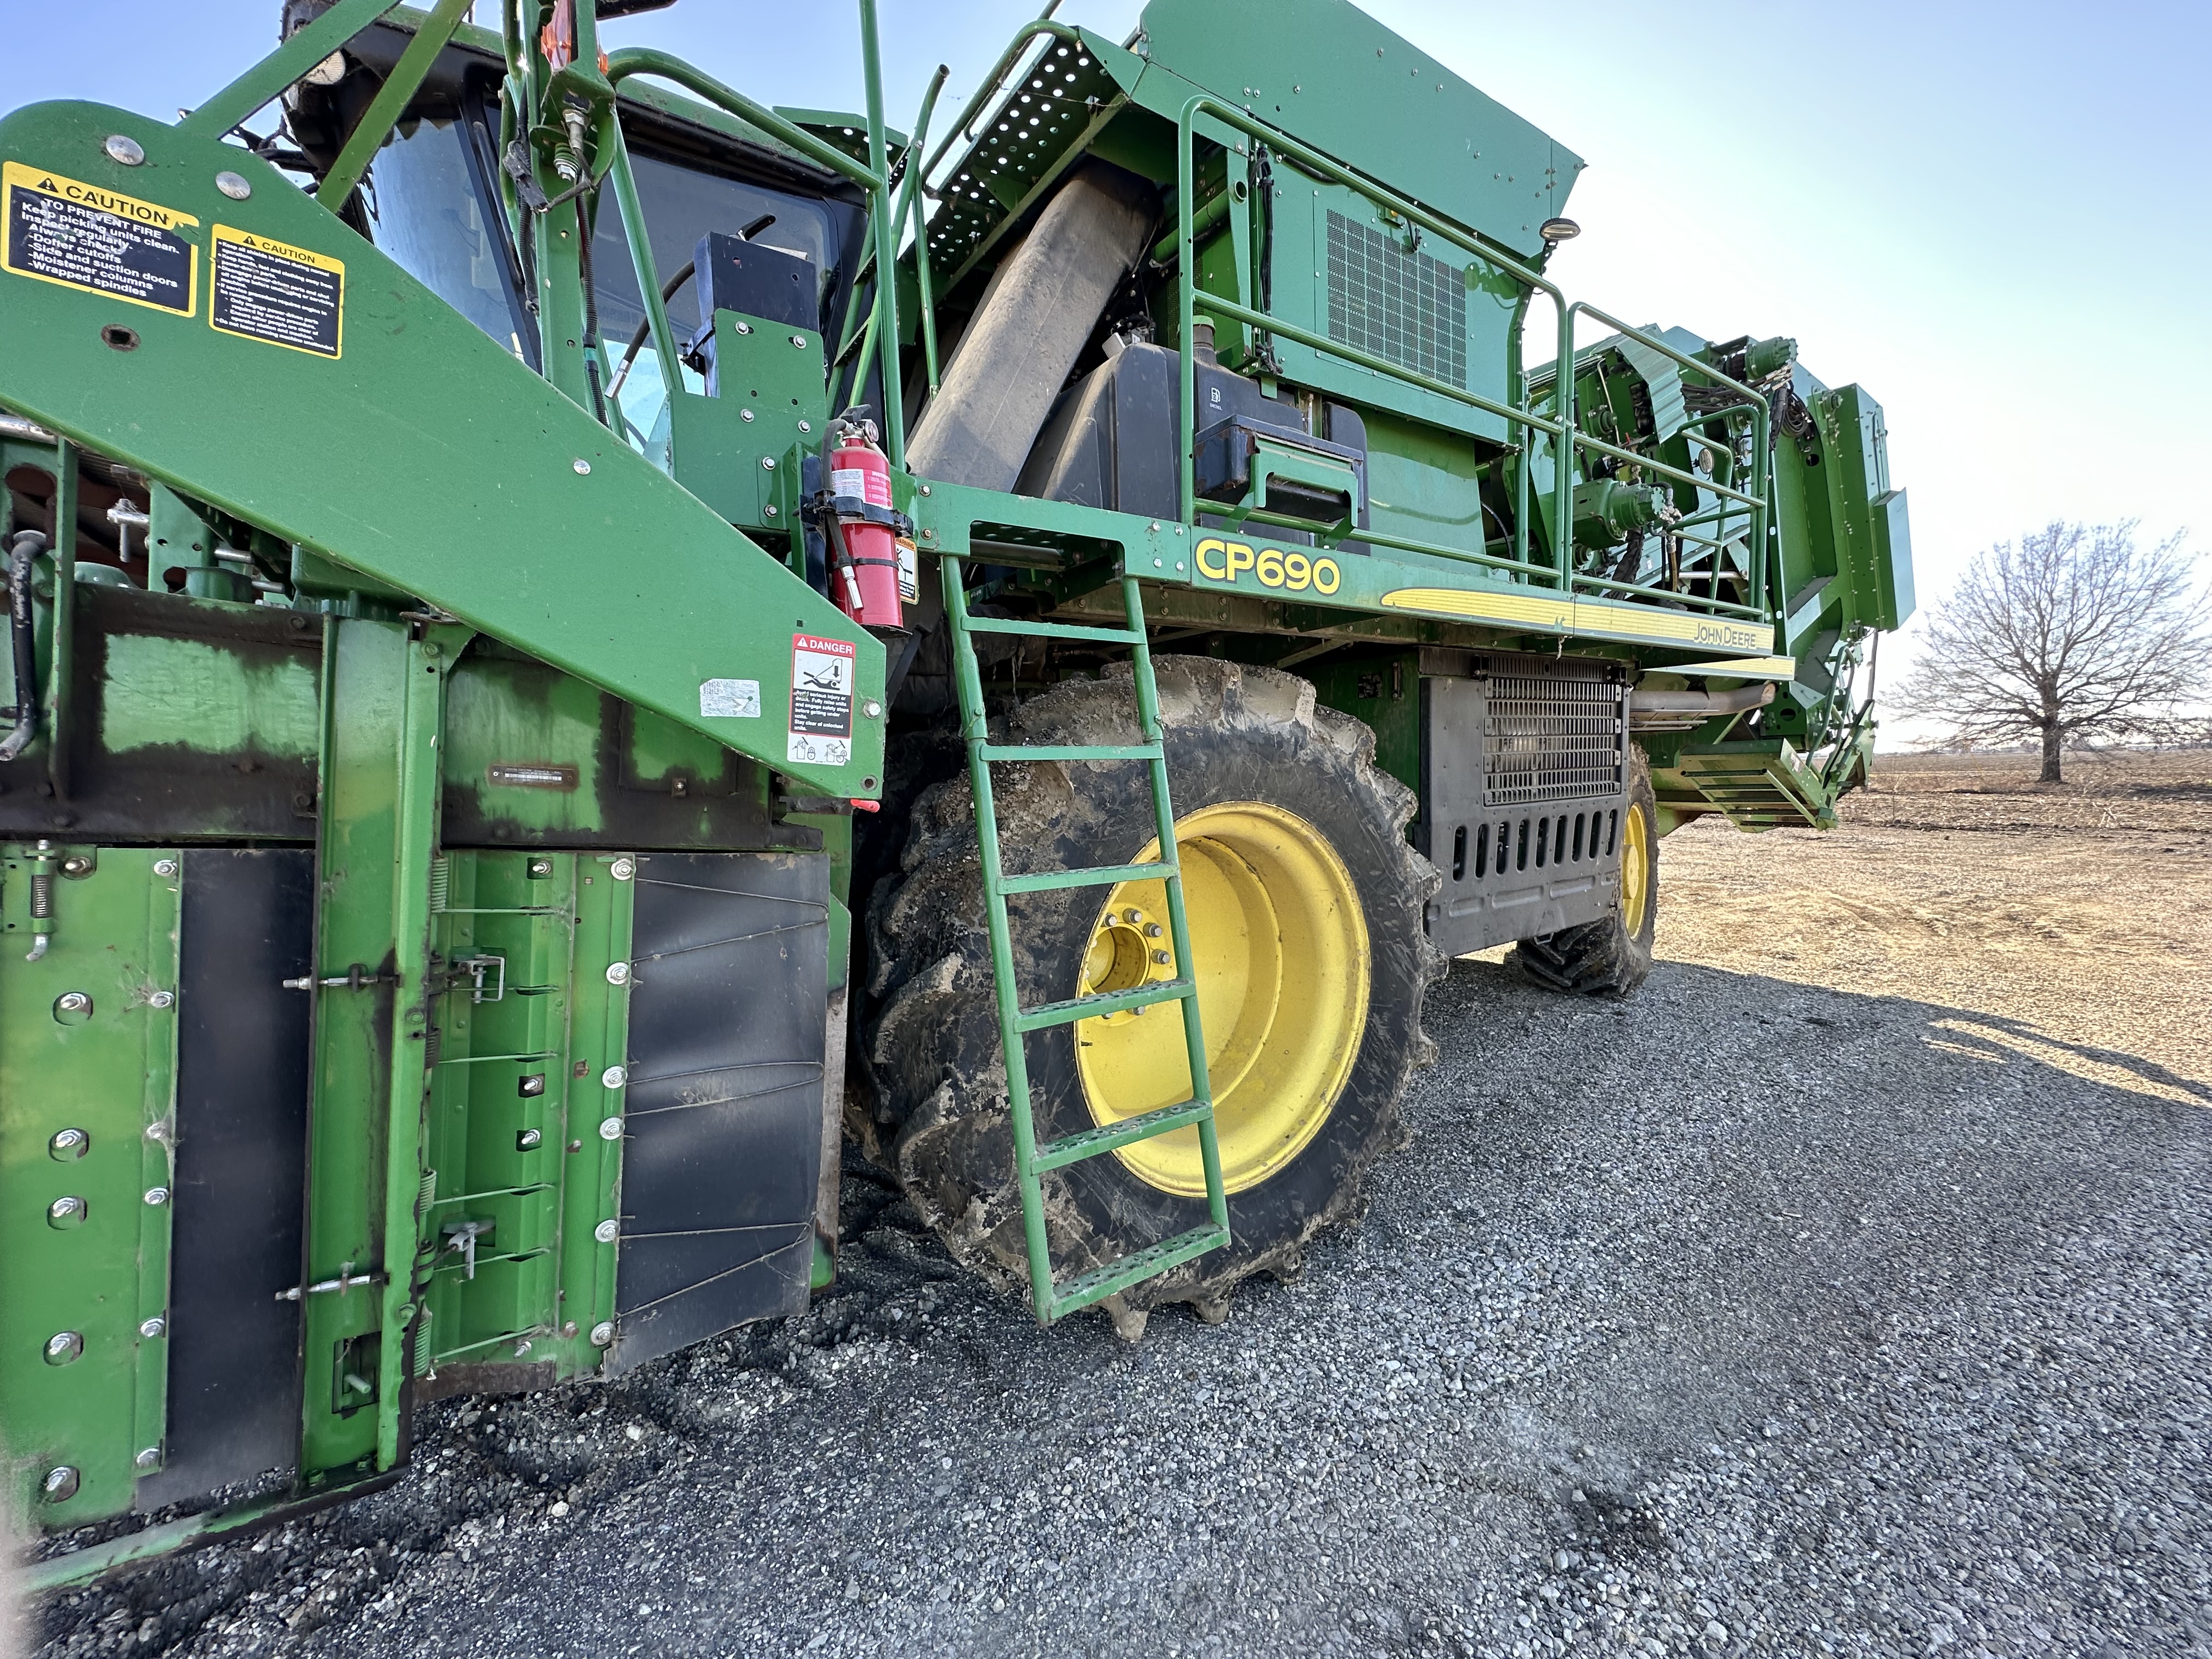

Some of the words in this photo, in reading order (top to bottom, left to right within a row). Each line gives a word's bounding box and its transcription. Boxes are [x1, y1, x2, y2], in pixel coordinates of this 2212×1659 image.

[43, 198, 64, 210] TO
[67, 205, 131, 229] PREVENT
[133, 224, 162, 240] FIRE
[66, 186, 167, 225] CAUTION
[21, 211, 71, 229] Inspect
[74, 227, 133, 250] regularly.
[22, 202, 56, 219] Keep
[60, 215, 106, 234] picking
[110, 229, 142, 242] units
[144, 239, 180, 254] clean.
[28, 242, 63, 257] -Side
[66, 253, 90, 264] and
[93, 260, 139, 278] suction
[143, 273, 178, 288] doors
[28, 251, 98, 275] -Moistener
[99, 270, 154, 290] columns
[77, 247, 122, 263] cutoffs
[262, 242, 315, 263] CAUTION
[28, 260, 91, 282] -Wrapped
[93, 278, 147, 297] spindles
[1195, 538, 1340, 595] CP690
[810, 639, 853, 654] DANGER
[1694, 623, 1722, 644] JOHN
[1724, 627, 1756, 647] DEERE
